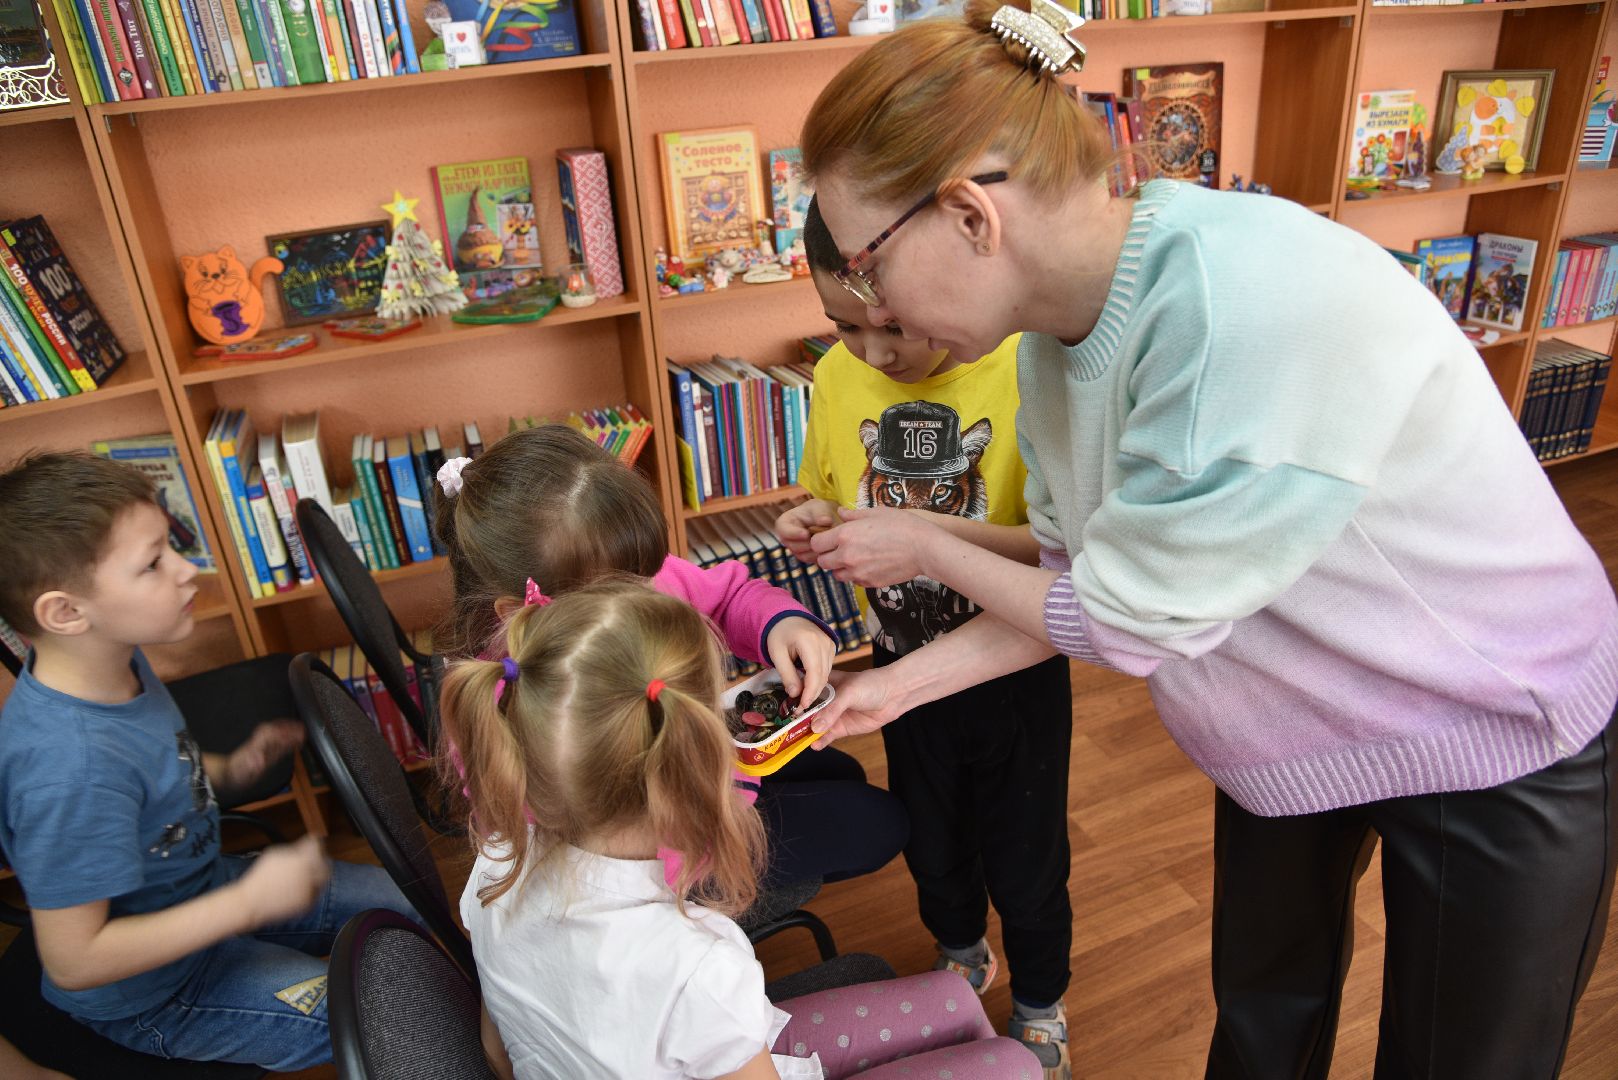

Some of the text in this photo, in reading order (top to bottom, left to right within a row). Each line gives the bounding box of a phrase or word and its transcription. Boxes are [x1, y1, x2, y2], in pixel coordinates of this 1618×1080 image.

[211, 0, 228, 42] ОГРАФИЯ
[127, 18, 145, 60] Том Тит
[682, 145, 742, 158] Соленое
[695, 157, 732, 168] тесто
[1490, 240, 1524, 253] ДРАКОНЫ
[38, 262, 73, 300] 100
[10, 263, 67, 346] 100 ЧУДЕС РОССИИ
[903, 428, 938, 459] 16
